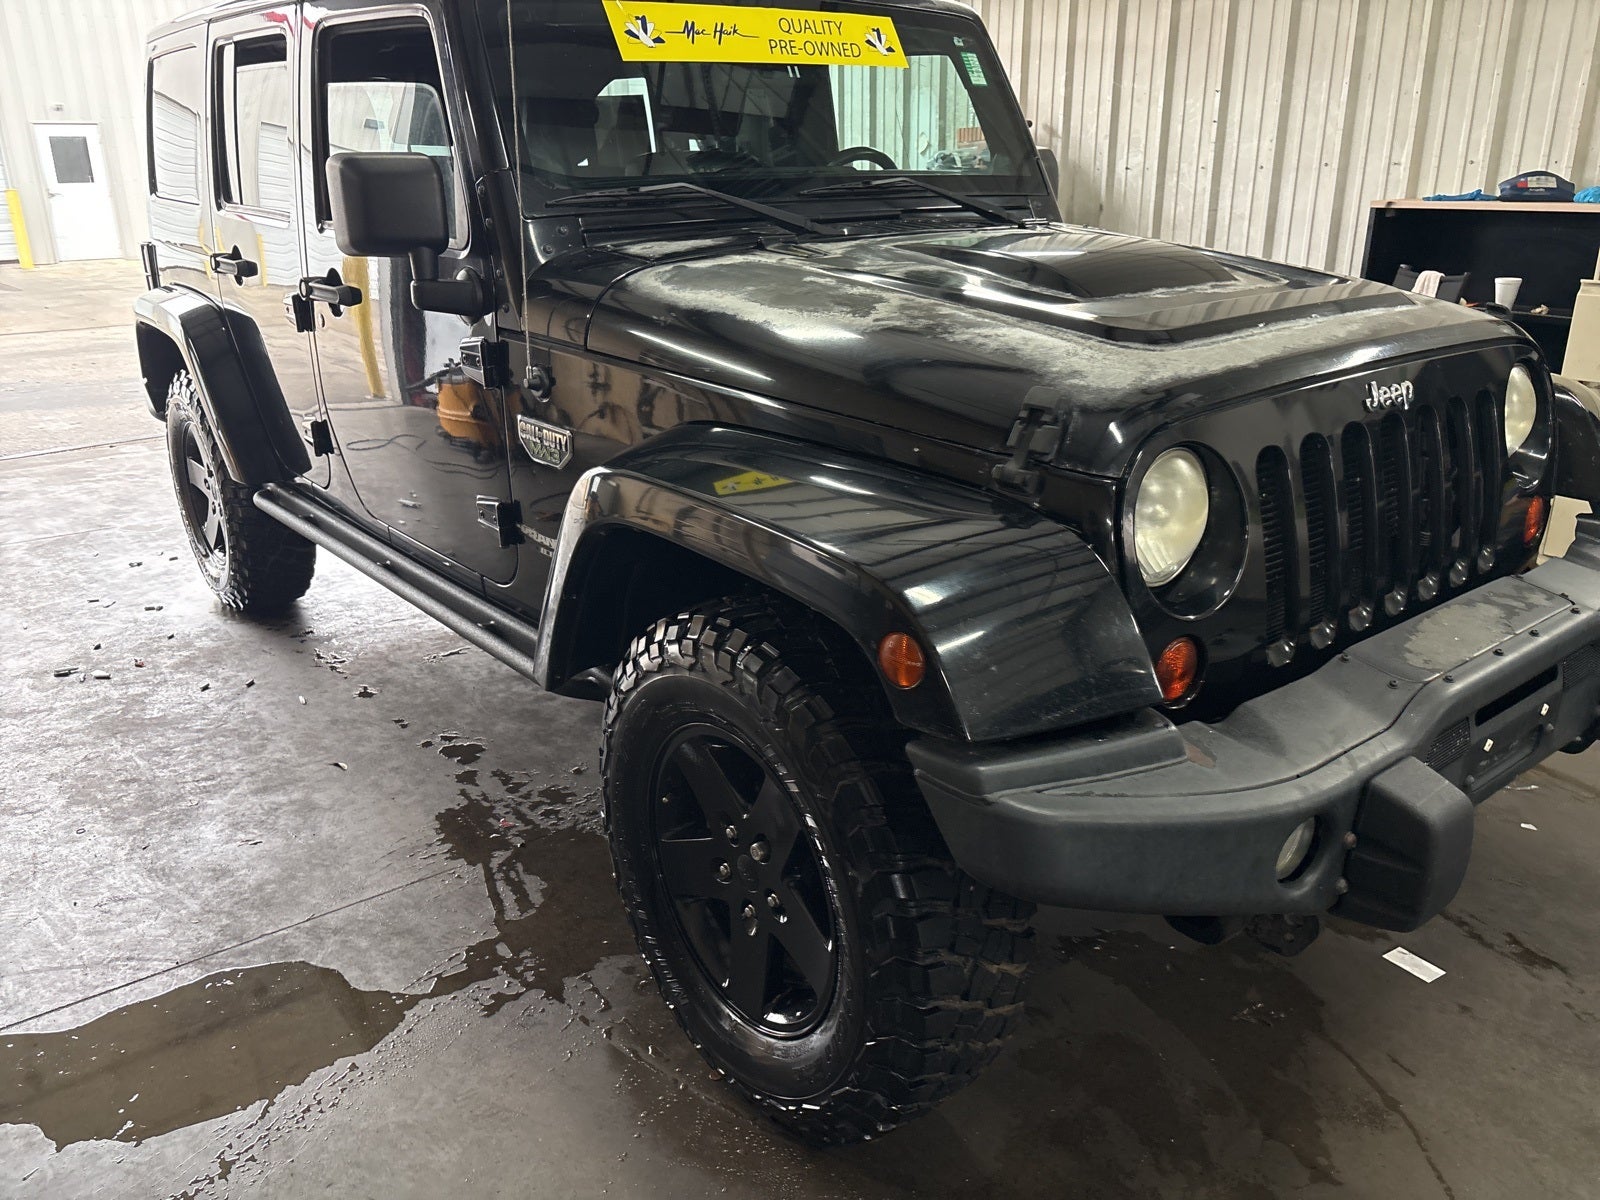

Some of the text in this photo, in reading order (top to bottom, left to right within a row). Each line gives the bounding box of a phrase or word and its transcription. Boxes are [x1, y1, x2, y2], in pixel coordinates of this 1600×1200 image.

[665, 20, 760, 46] Mac Haik
[778, 17, 842, 35] QUALITY
[768, 38, 861, 58] PRE-OWNED
[1365, 380, 1414, 412] Jeep
[519, 421, 541, 443] CALL
[542, 428, 567, 452] DUTY
